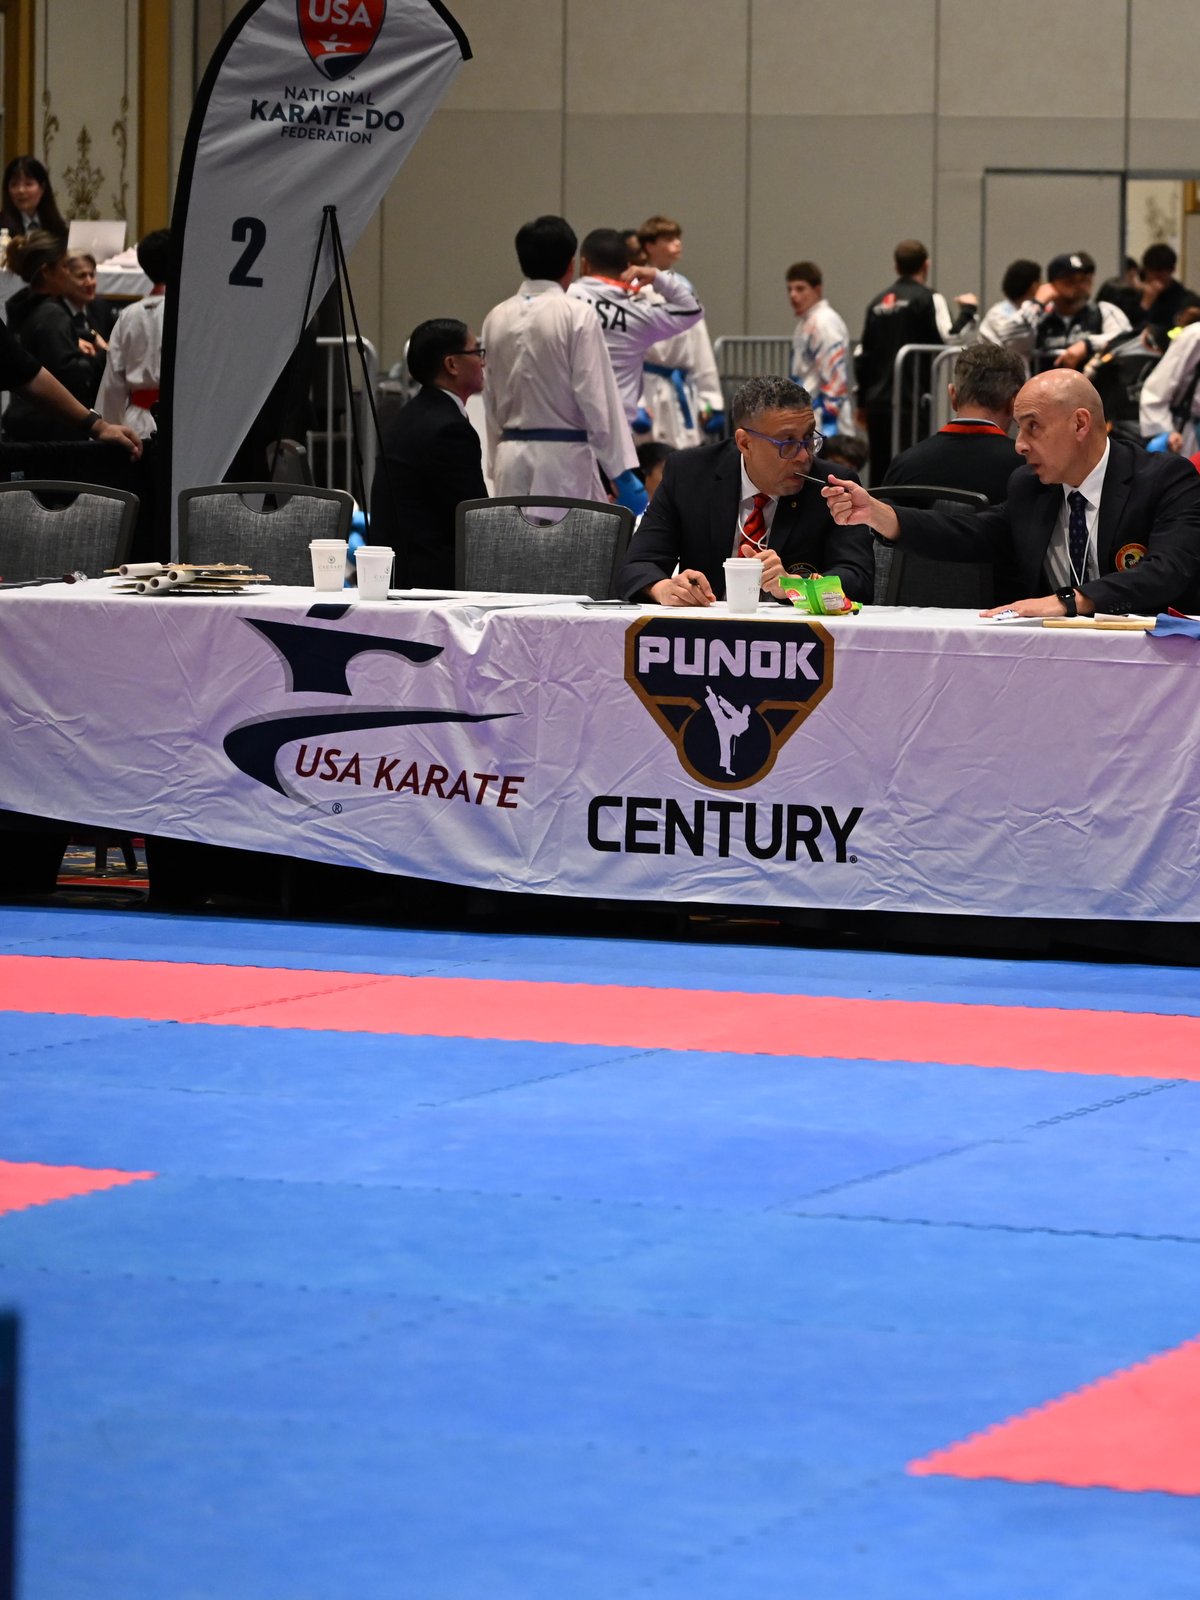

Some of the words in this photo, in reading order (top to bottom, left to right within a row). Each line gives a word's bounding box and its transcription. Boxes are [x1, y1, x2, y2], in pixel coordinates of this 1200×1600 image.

[309, 0, 372, 28] USA
[284, 85, 375, 106] NATIONAL
[250, 99, 405, 132] KARATE-DO
[281, 125, 373, 144] FEDERATION
[229, 216, 266, 288] 2
[638, 635, 820, 680] PUNOK
[295, 744, 361, 786] USA
[373, 756, 525, 809] KARATE
